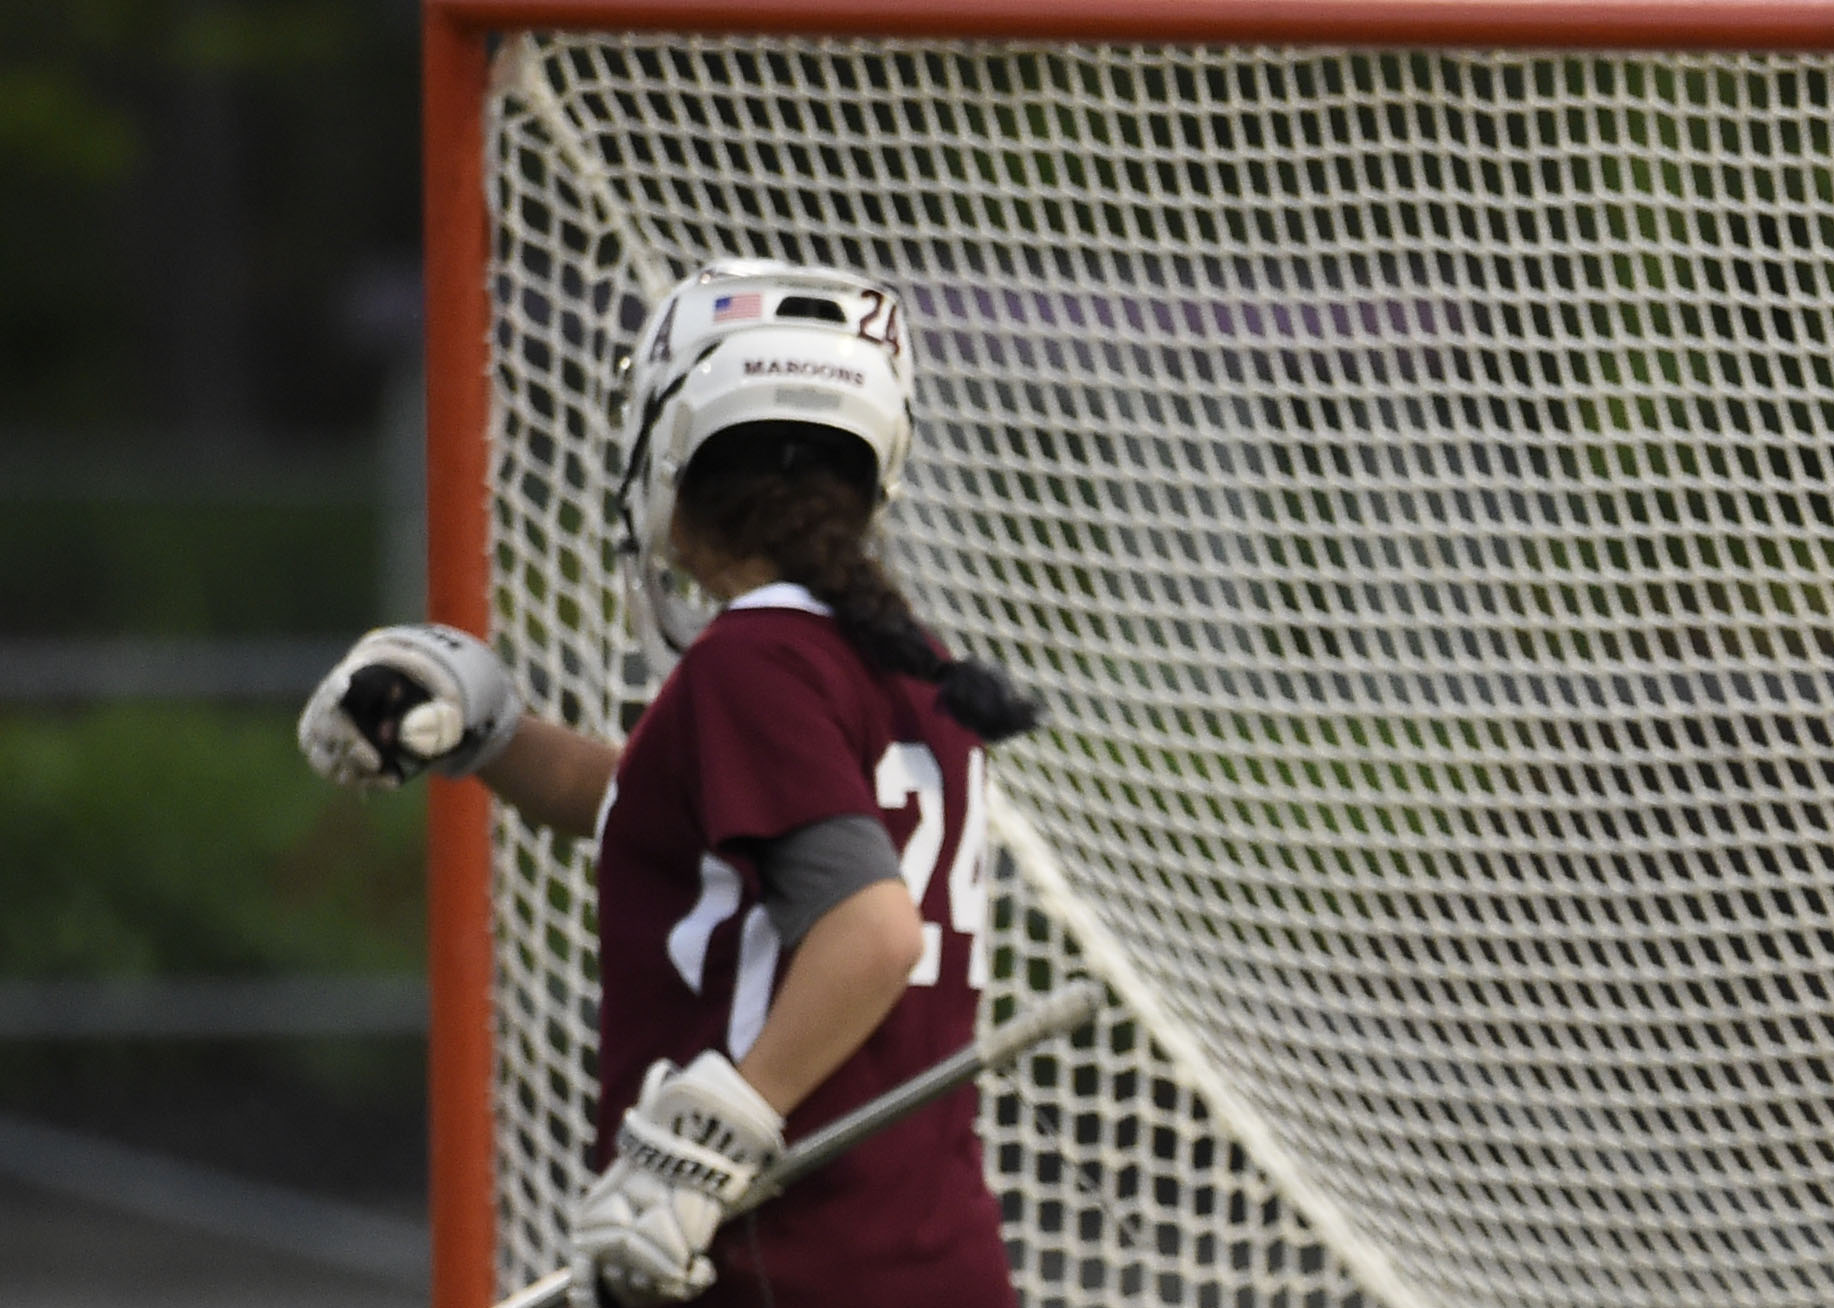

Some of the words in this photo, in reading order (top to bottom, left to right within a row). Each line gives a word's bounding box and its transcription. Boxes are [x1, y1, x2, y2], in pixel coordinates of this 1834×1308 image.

[857, 289, 900, 355] 24
[743, 360, 865, 387] MAROONS
[874, 741, 988, 989] 24
